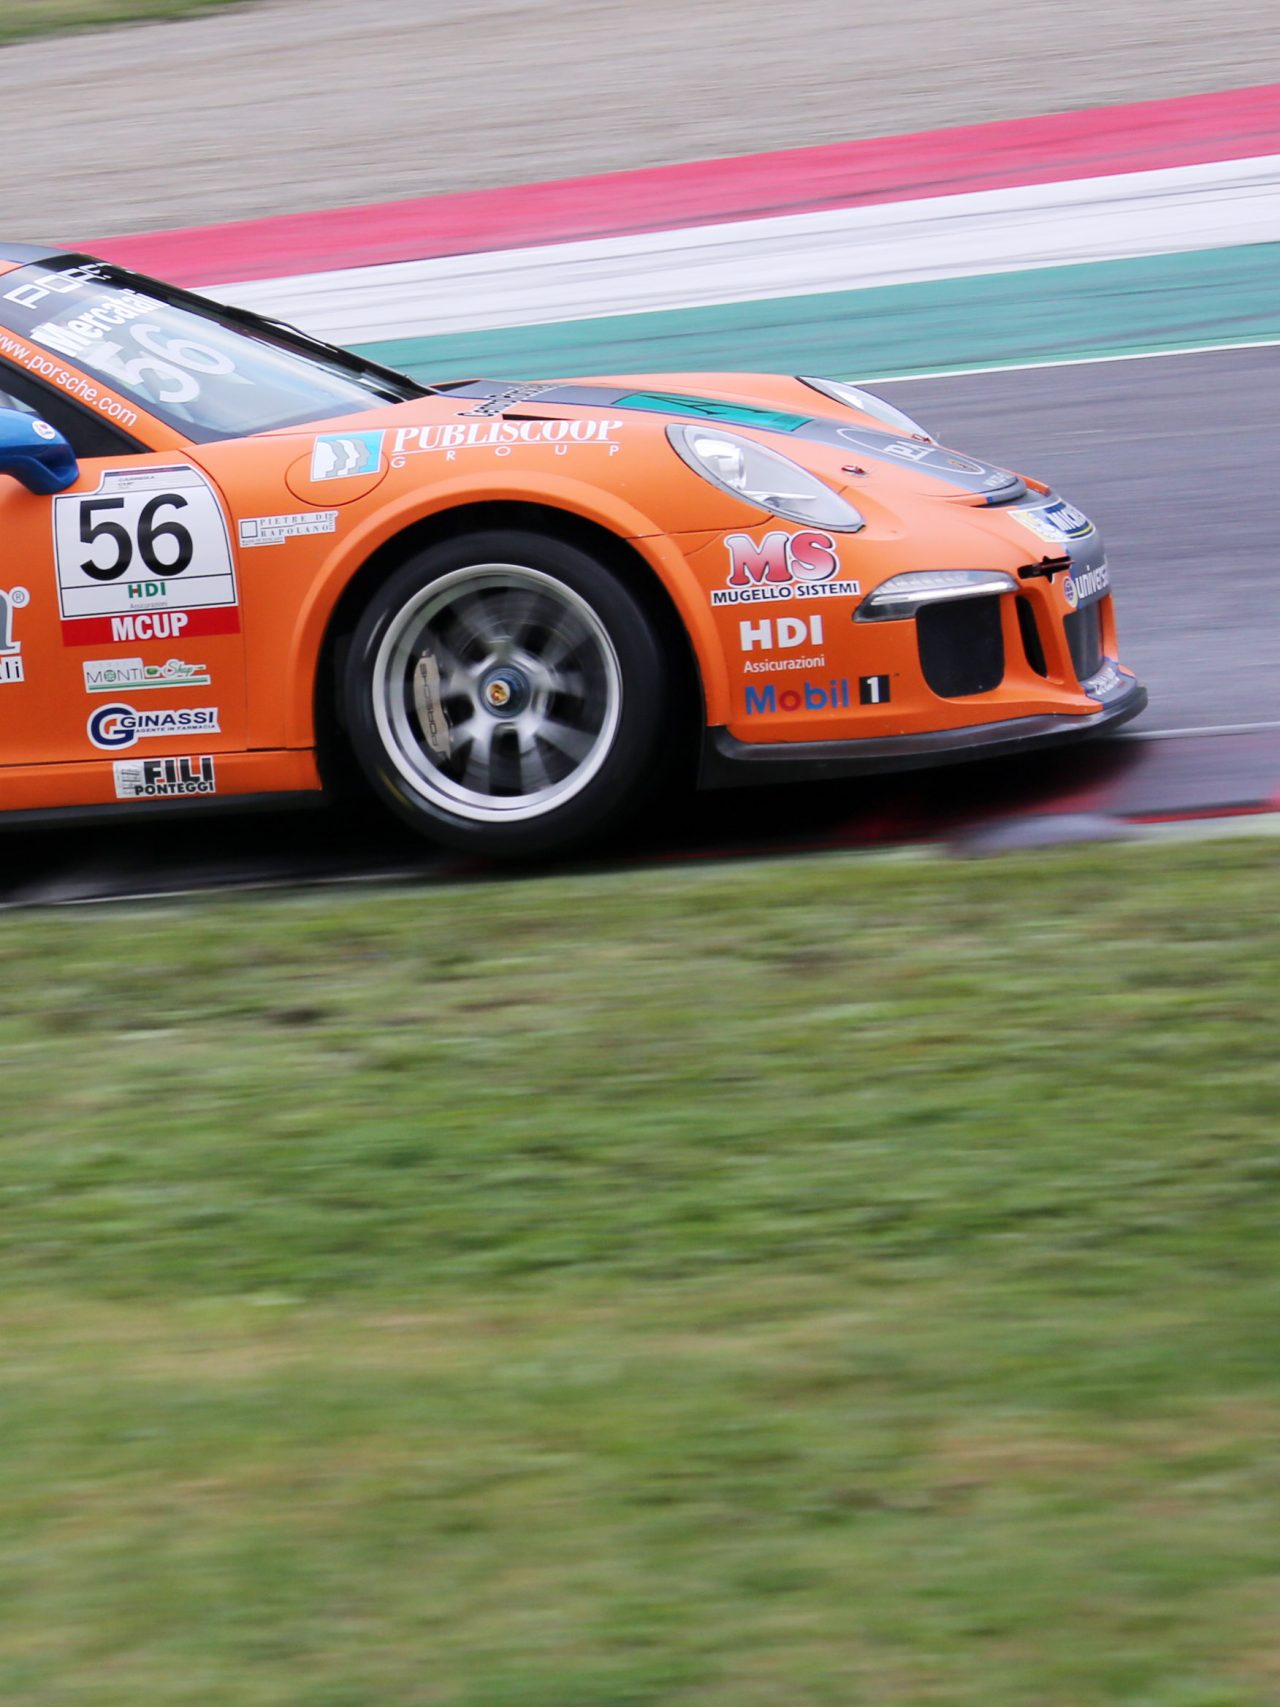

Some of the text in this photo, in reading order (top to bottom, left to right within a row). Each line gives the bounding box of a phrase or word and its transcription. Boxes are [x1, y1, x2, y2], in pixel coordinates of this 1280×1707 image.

[392, 420, 624, 453] PUBLISCOOP
[80, 493, 194, 581] 56
[725, 532, 837, 586] MS
[128, 582, 167, 599] HDI
[713, 583, 858, 604] MUGELLO SISTEMI
[111, 612, 188, 642] MCUP
[739, 614, 823, 652] HDI
[743, 654, 825, 674] Assicurazioni
[744, 676, 880, 715] Mobil 1
[120, 711, 214, 728] GINASSI
[135, 782, 214, 795] PONTEGGI
